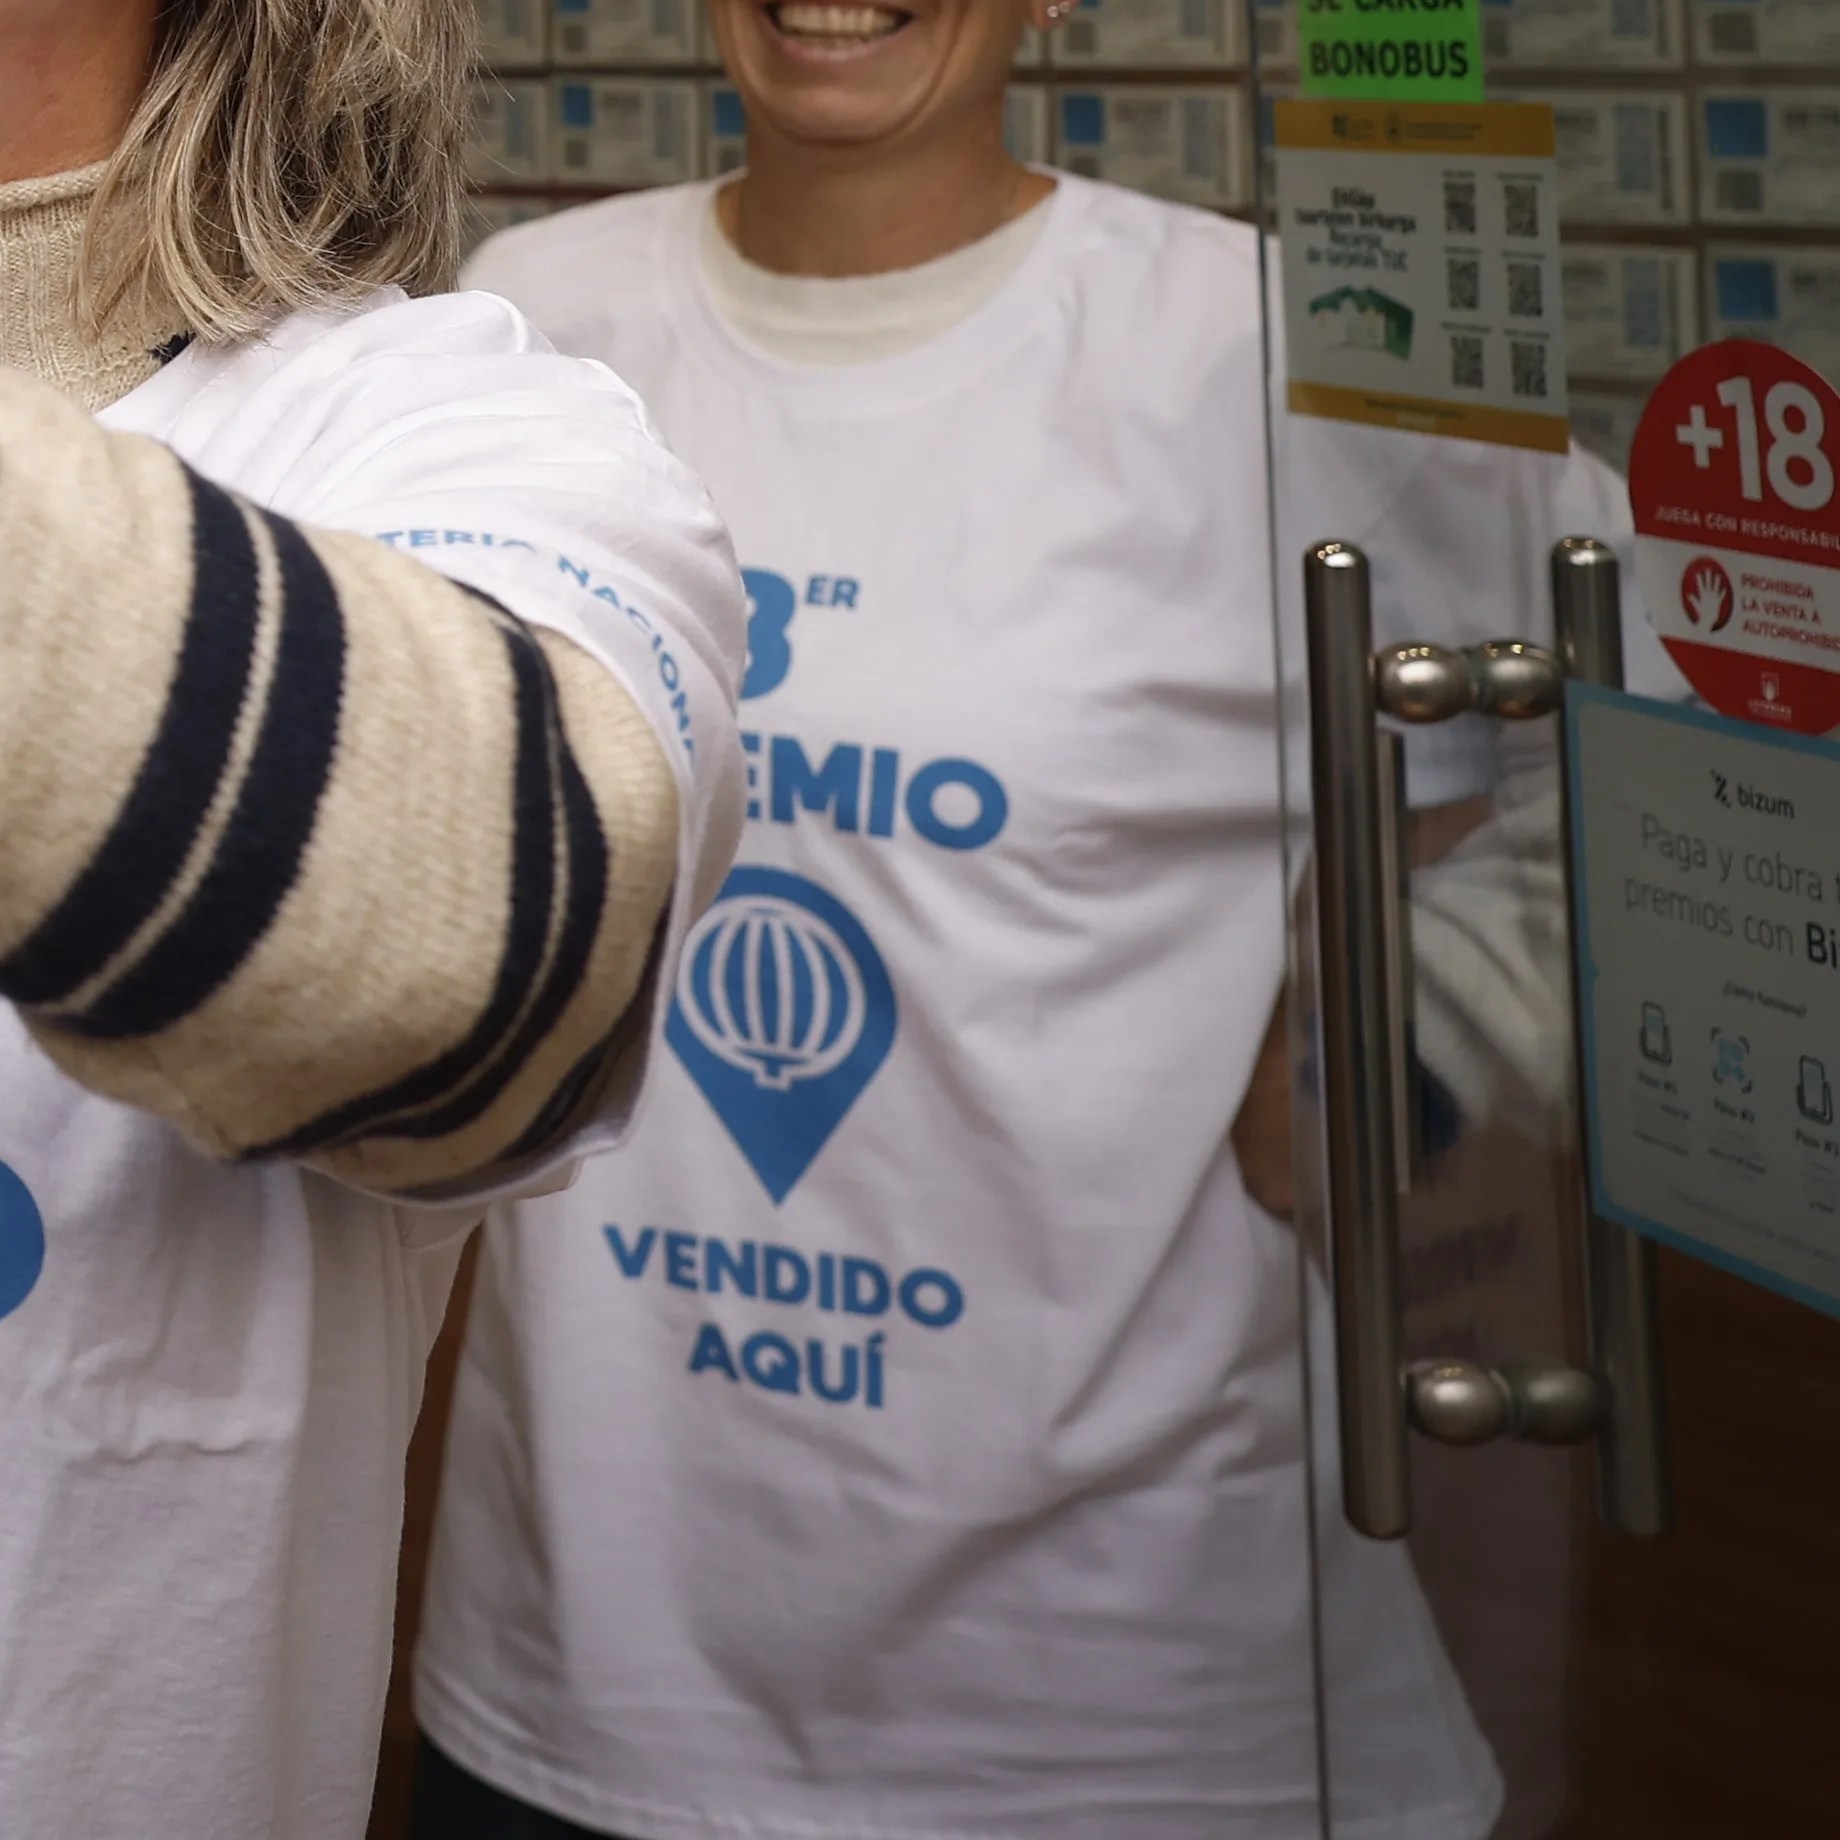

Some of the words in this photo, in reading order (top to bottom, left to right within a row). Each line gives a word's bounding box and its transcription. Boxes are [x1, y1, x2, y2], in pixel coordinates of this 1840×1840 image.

[1308, 40, 1470, 80] BONOBUS
[1674, 375, 1835, 511] +18
[1736, 780, 1796, 820] bizum
[1640, 811, 1708, 873] Paga
[1717, 845, 1734, 884] y
[1742, 850, 1824, 904] cobra
[1624, 875, 1734, 939] premios
[1743, 914, 1795, 956] con
[601, 1222, 965, 1329] VENDIDO
[687, 1320, 886, 1410] AQUÍ
